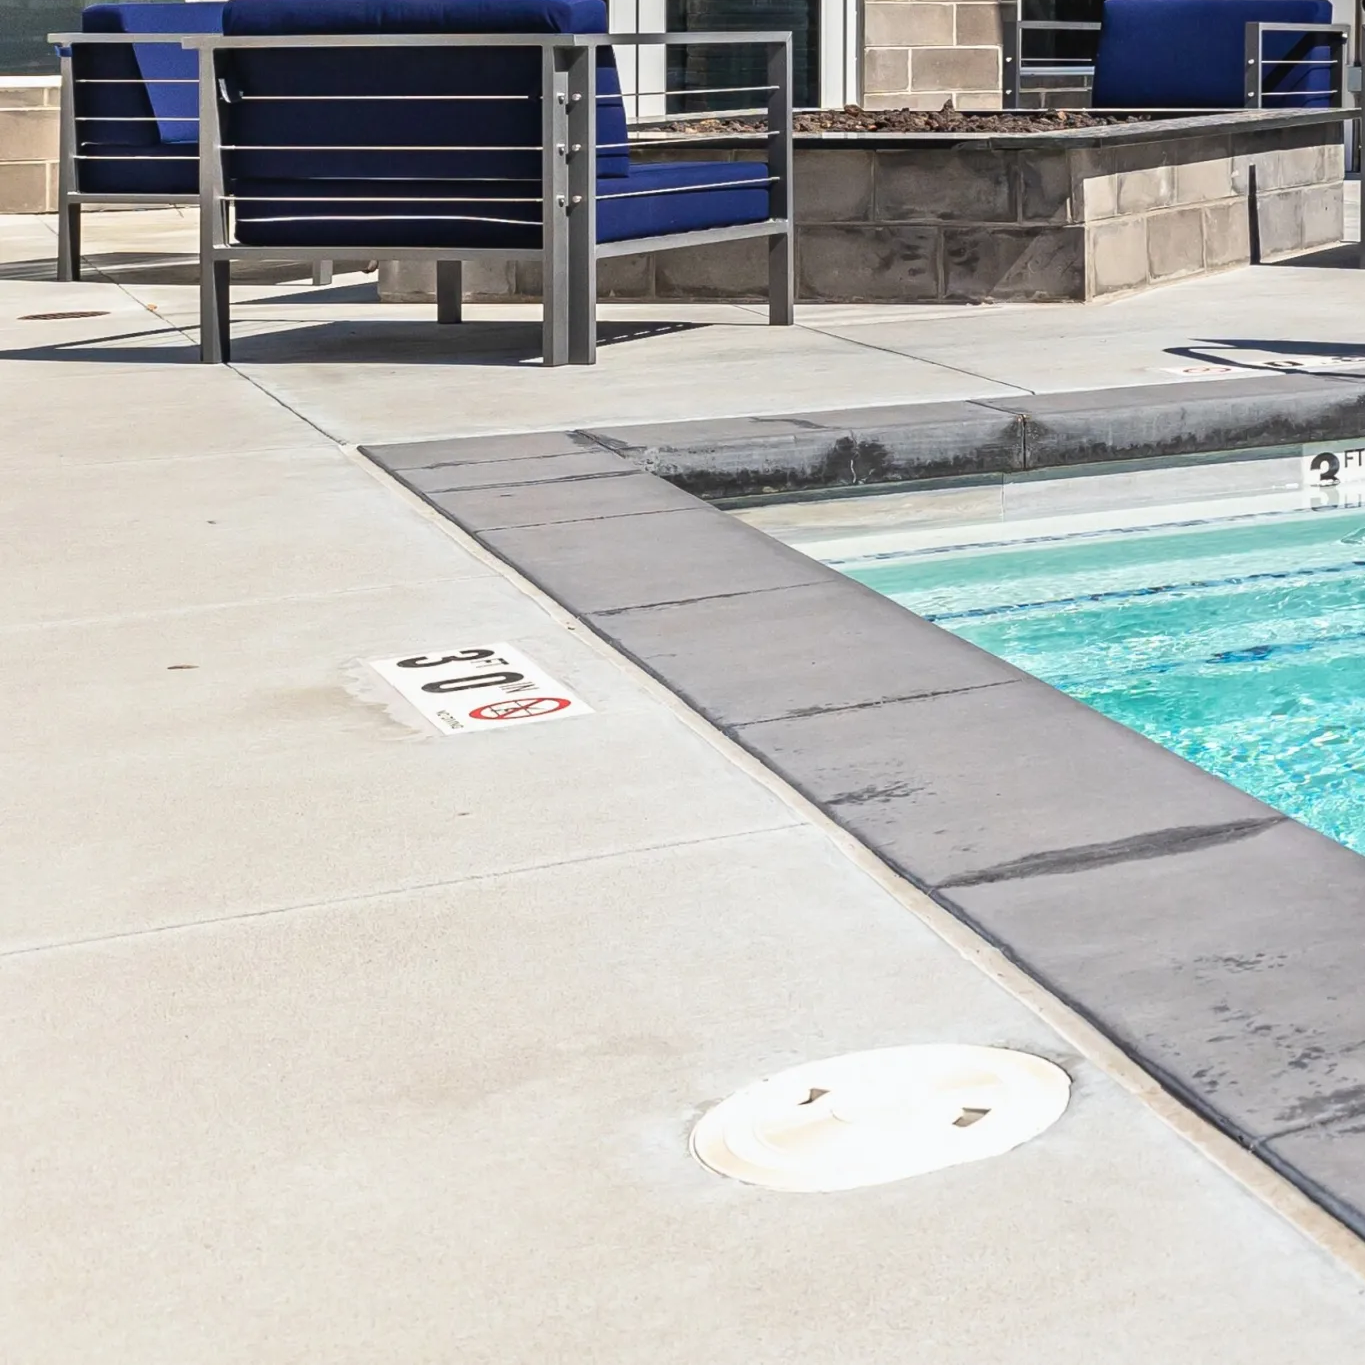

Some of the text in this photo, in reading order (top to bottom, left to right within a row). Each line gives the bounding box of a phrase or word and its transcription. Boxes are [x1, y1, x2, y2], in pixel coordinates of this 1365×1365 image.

[1310, 452, 1340, 486] 3
[1345, 448, 1365, 468] FT
[396, 649, 495, 668] 3
[421, 671, 524, 693] 0
